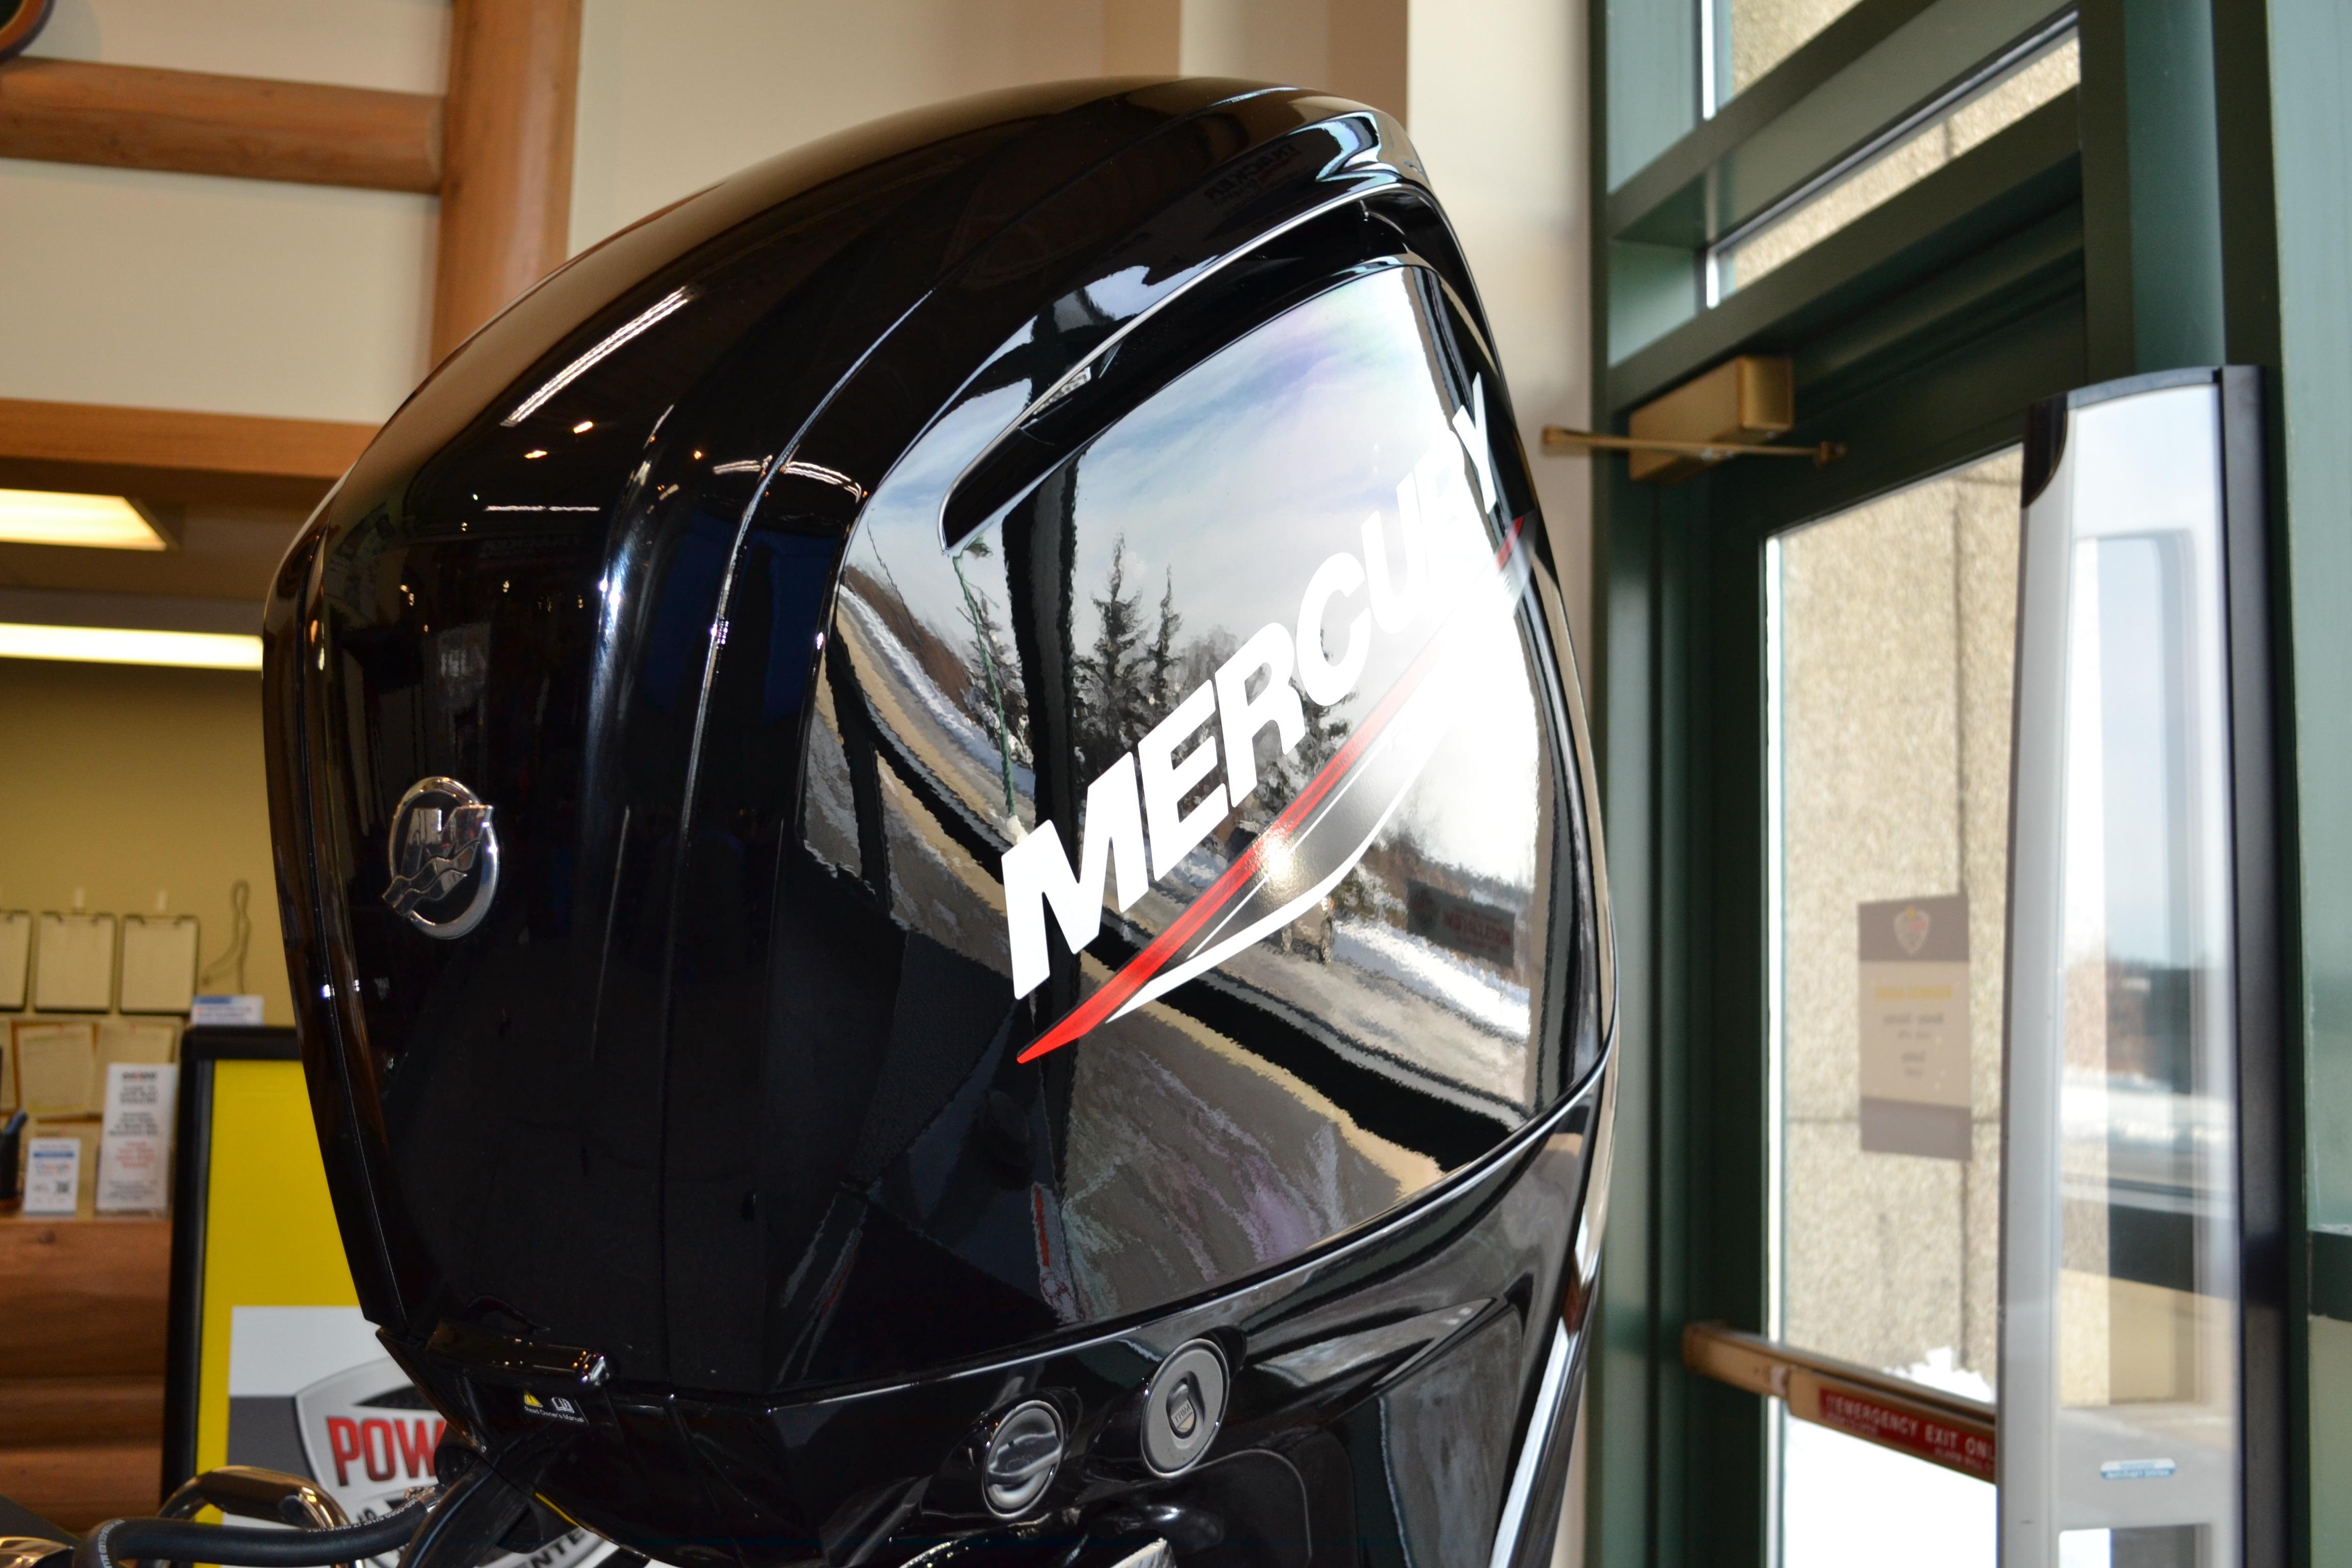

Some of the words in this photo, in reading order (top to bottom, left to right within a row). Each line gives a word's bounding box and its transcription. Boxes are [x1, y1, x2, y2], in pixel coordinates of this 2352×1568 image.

[1001, 372, 1497, 999] MERCURY
[524, 1406, 540, 1414] Read
[540, 1409, 564, 1419] Owner's
[562, 1413, 584, 1423] Manual
[1174, 1404, 1191, 1423] TRIM
[1924, 1424, 1958, 1449] EXIT
[1966, 1436, 1995, 1465] ONL
